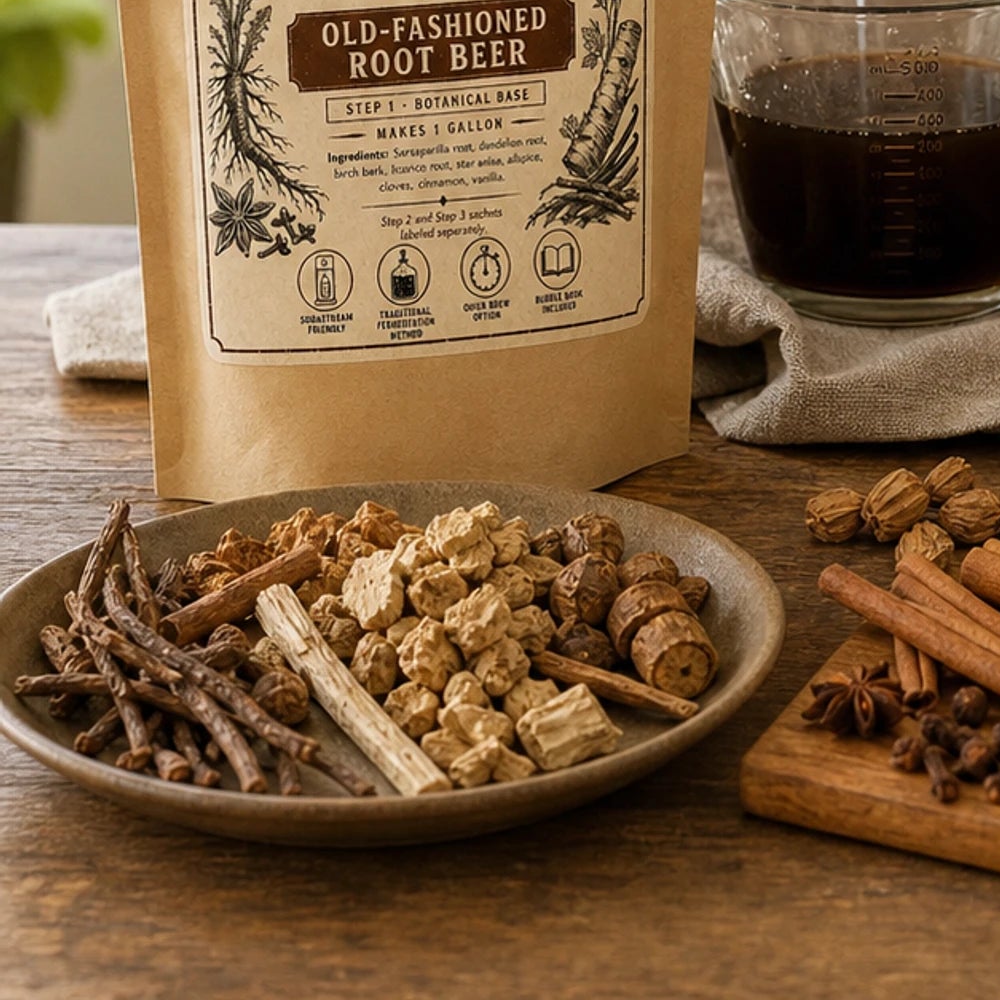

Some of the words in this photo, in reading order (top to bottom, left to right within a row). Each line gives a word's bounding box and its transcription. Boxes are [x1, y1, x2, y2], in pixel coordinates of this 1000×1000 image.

[321, 5, 547, 47] OLD-FASHIONED
[349, 46, 434, 79] ROOT
[450, 39, 527, 71] BEER
[346, 101, 381, 115] STEP
[388, 100, 394, 112] 1
[414, 92, 491, 110] BOTANICAL
[497, 88, 530, 101] BASE
[376, 124, 426, 140] MAKES
[434, 123, 439, 135] 1
[447, 117, 503, 134] GALLON
[381, 215, 403, 229] Step
[405, 214, 411, 225] 2
[436, 211, 457, 224] Step
[459, 209, 466, 220] 3
